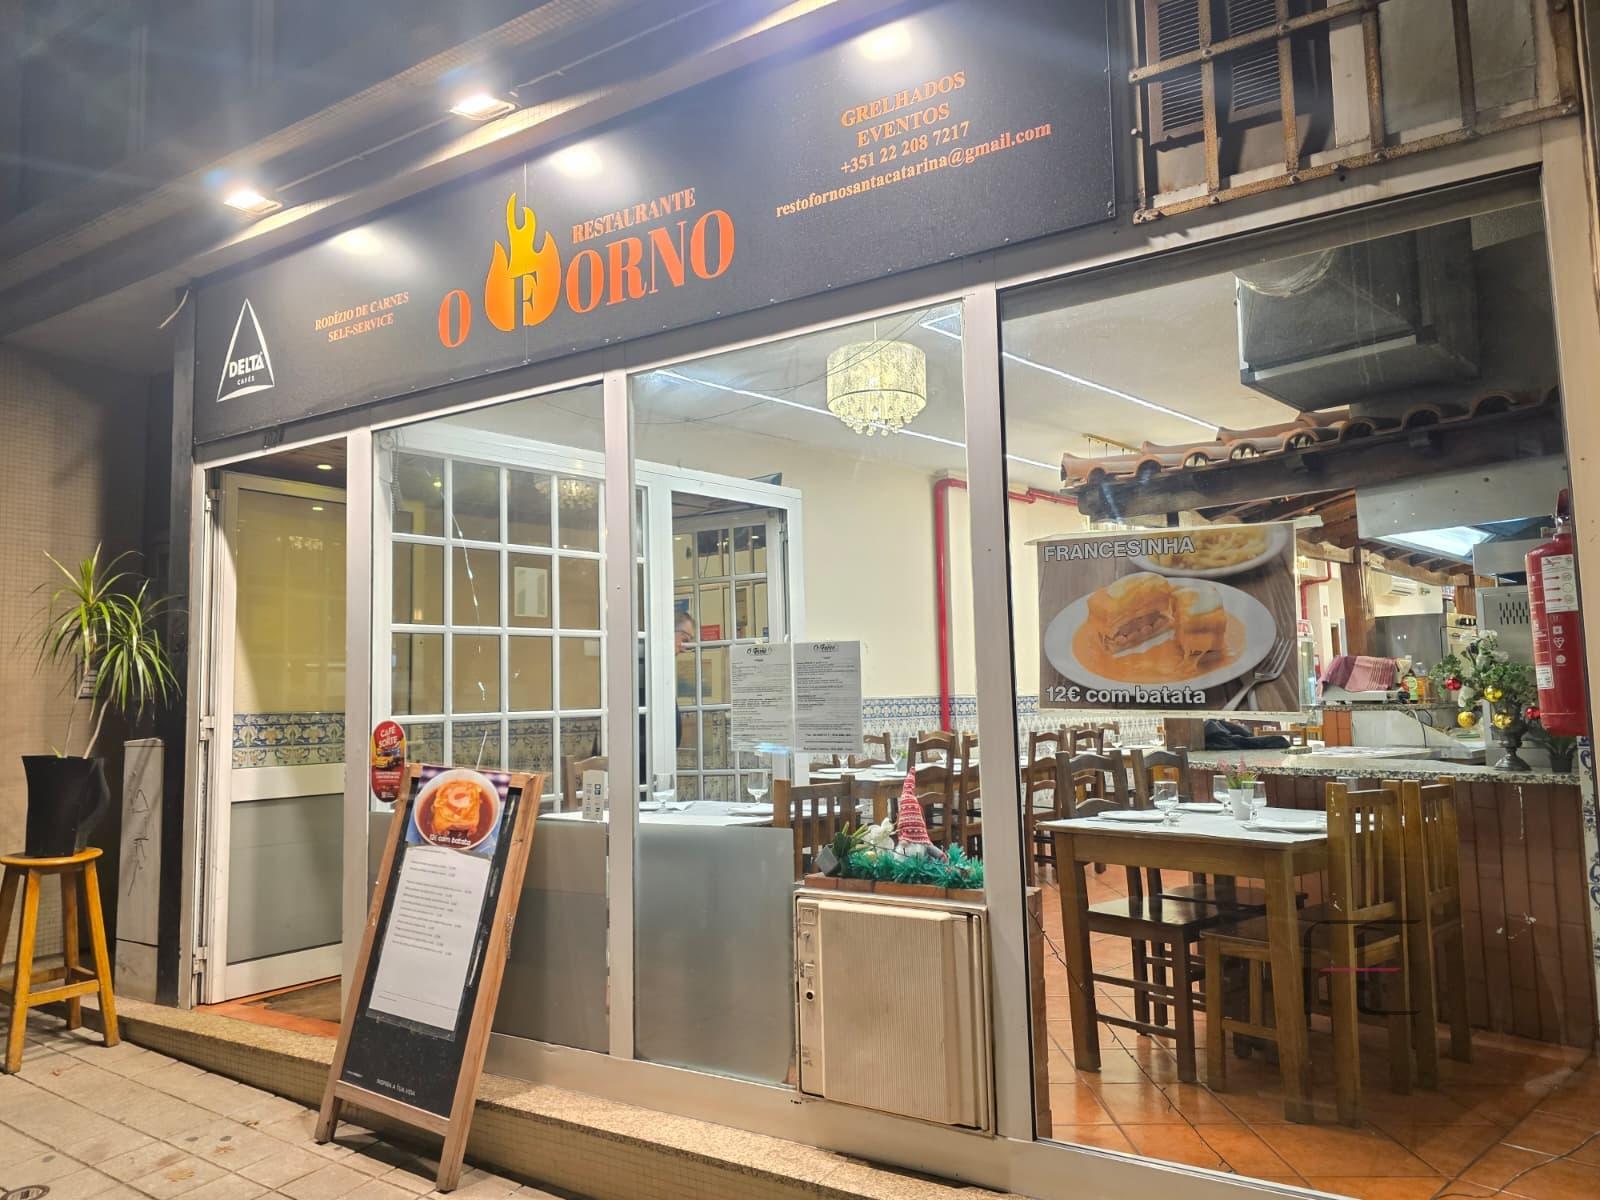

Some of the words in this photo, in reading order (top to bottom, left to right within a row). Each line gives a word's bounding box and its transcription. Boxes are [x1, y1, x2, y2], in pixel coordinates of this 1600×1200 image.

[840, 71, 967, 128] GRELHADOS
[840, 153, 876, 174] +351
[879, 145, 897, 164] 22
[901, 135, 929, 158] 208
[933, 121, 971, 147] 7217
[856, 103, 951, 148] EVENTOS
[775, 122, 1052, 218] restofornosantacatarina@gmail.com
[572, 187, 696, 244] RESTAURANTE
[315, 310, 354, 331] RODÍZIO
[355, 303, 369, 318] DE
[370, 291, 410, 313] CARNES
[327, 312, 395, 343] SELF-SERVICE
[438, 289, 472, 348] O
[1043, 535, 1196, 562] FRANCESINHA
[1045, 685, 1081, 704] 12€
[1085, 688, 1131, 704] com
[1135, 685, 1207, 705] batata
